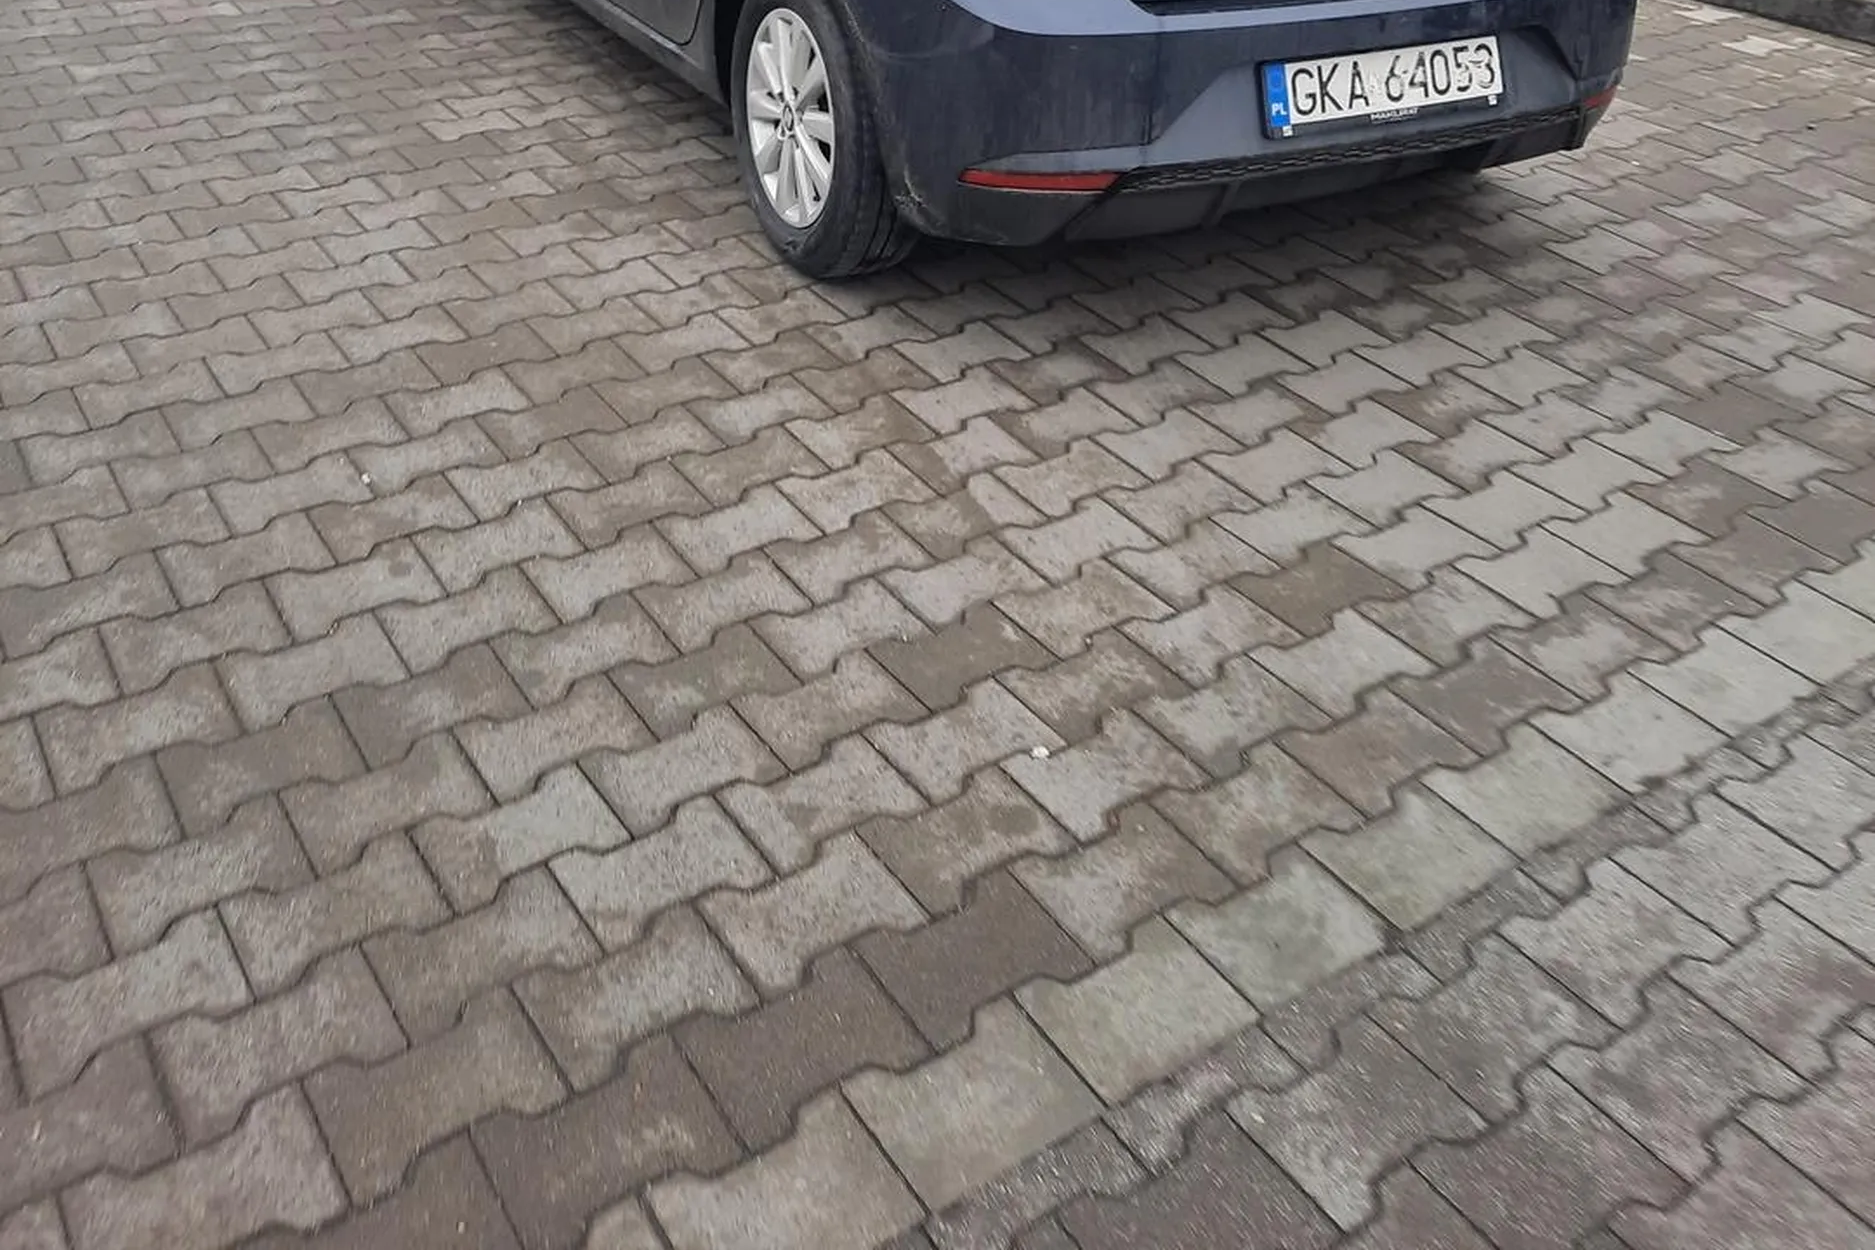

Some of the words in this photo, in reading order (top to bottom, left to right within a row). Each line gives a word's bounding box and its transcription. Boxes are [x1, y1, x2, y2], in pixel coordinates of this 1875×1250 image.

[1291, 59, 1369, 116] GKA
[1384, 43, 1495, 103] 64053
[1271, 102, 1288, 116] PL
